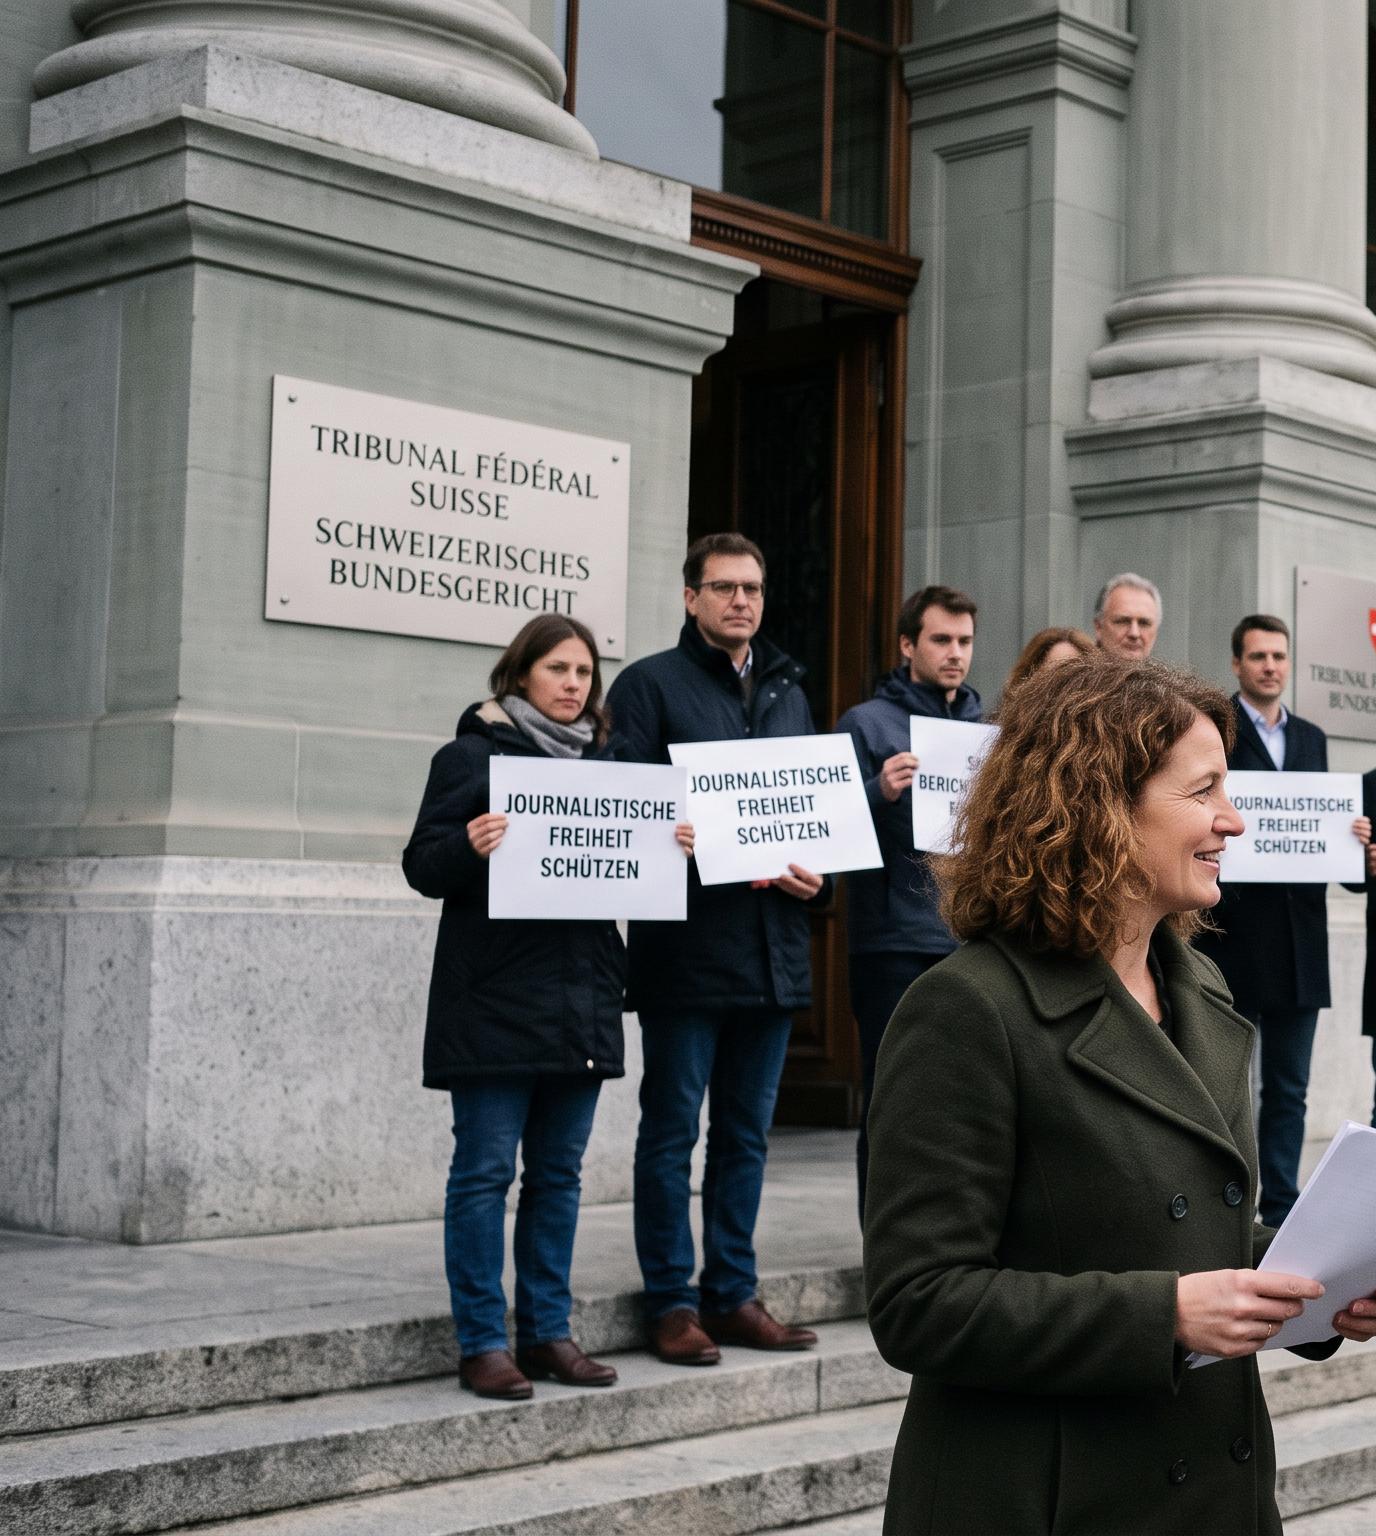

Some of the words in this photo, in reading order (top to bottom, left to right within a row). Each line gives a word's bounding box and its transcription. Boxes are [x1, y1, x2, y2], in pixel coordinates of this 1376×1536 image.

[310, 424, 466, 476] TRIBUNAL
[475, 452, 600, 499] FÉDÉRAL
[410, 480, 510, 520] SUISSE
[315, 517, 590, 582] SCHWEIZERISCHES
[329, 558, 578, 615] BUNDESGERICHT
[690, 765, 852, 794] JOURNALISTISCHE
[504, 793, 676, 820] JOURNALISTISCHE
[737, 795, 815, 817] FREIHEIT
[549, 826, 633, 849] FREIHEIT
[737, 820, 831, 845] SCHÜTZEN
[1258, 818, 1320, 832] FREIHEIT
[1254, 836, 1326, 853] SCHÜTZEN
[540, 854, 639, 879] SCHÜTZEN
